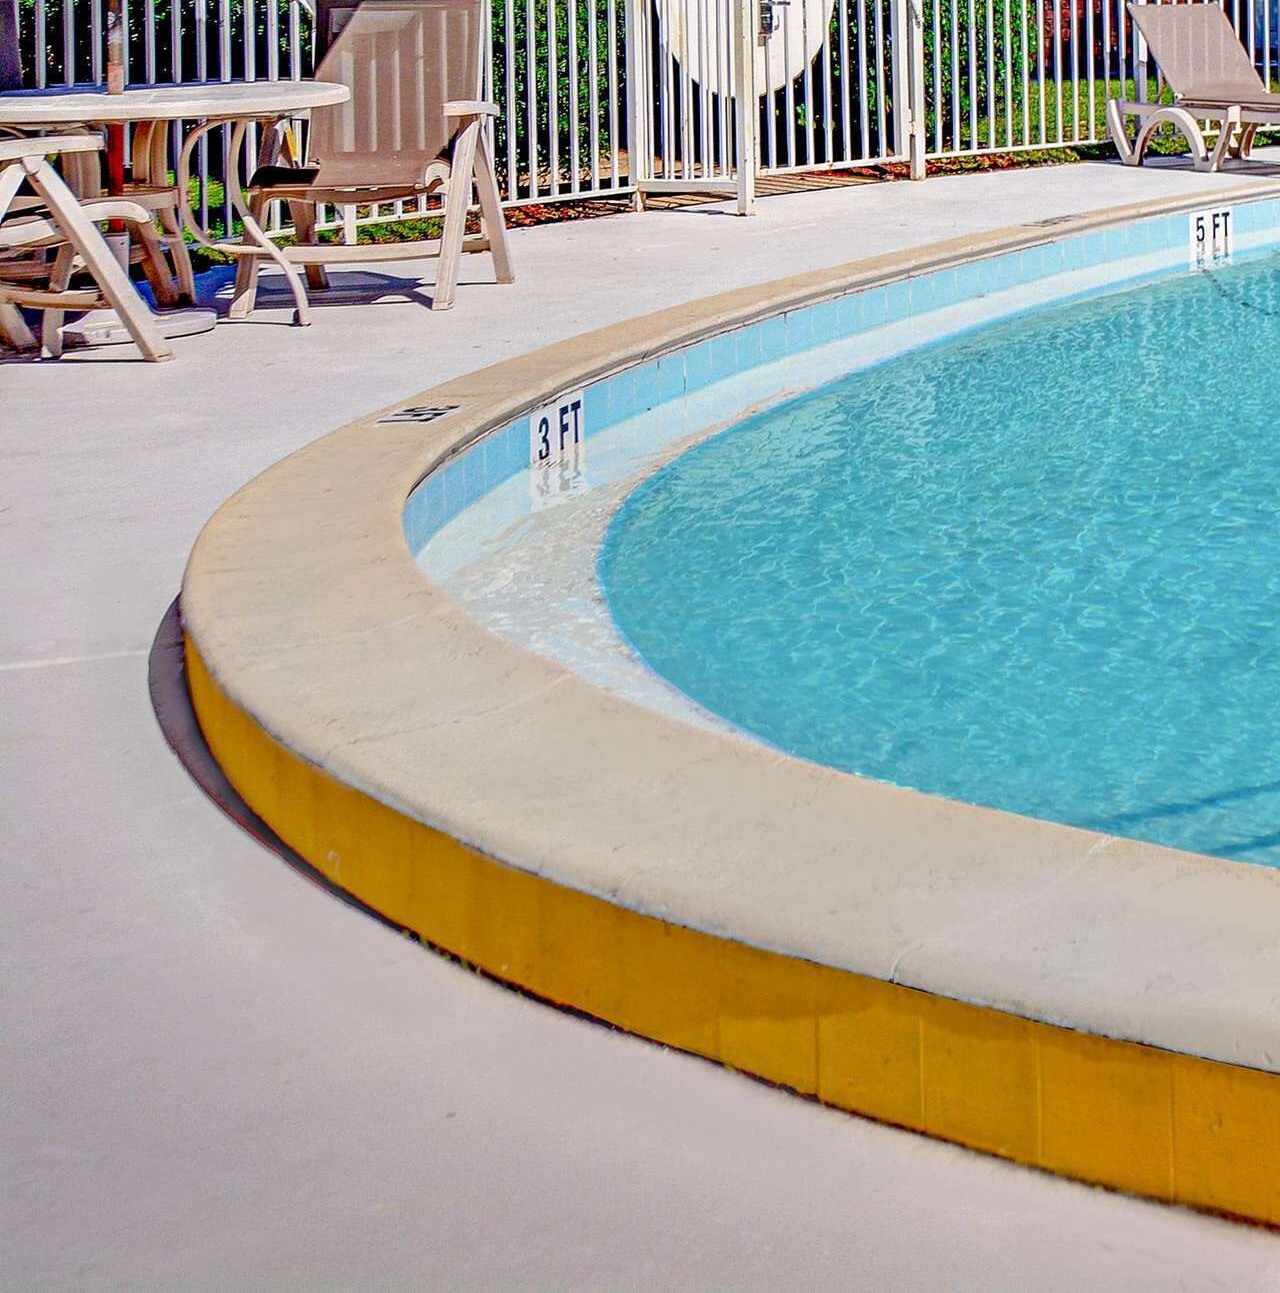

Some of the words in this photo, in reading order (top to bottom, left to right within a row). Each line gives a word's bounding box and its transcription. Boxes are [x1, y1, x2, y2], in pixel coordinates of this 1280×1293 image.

[1196, 216, 1205, 242] 5
[1212, 212, 1230, 240] FT
[538, 417, 549, 460] 3
[559, 400, 582, 451] FT
